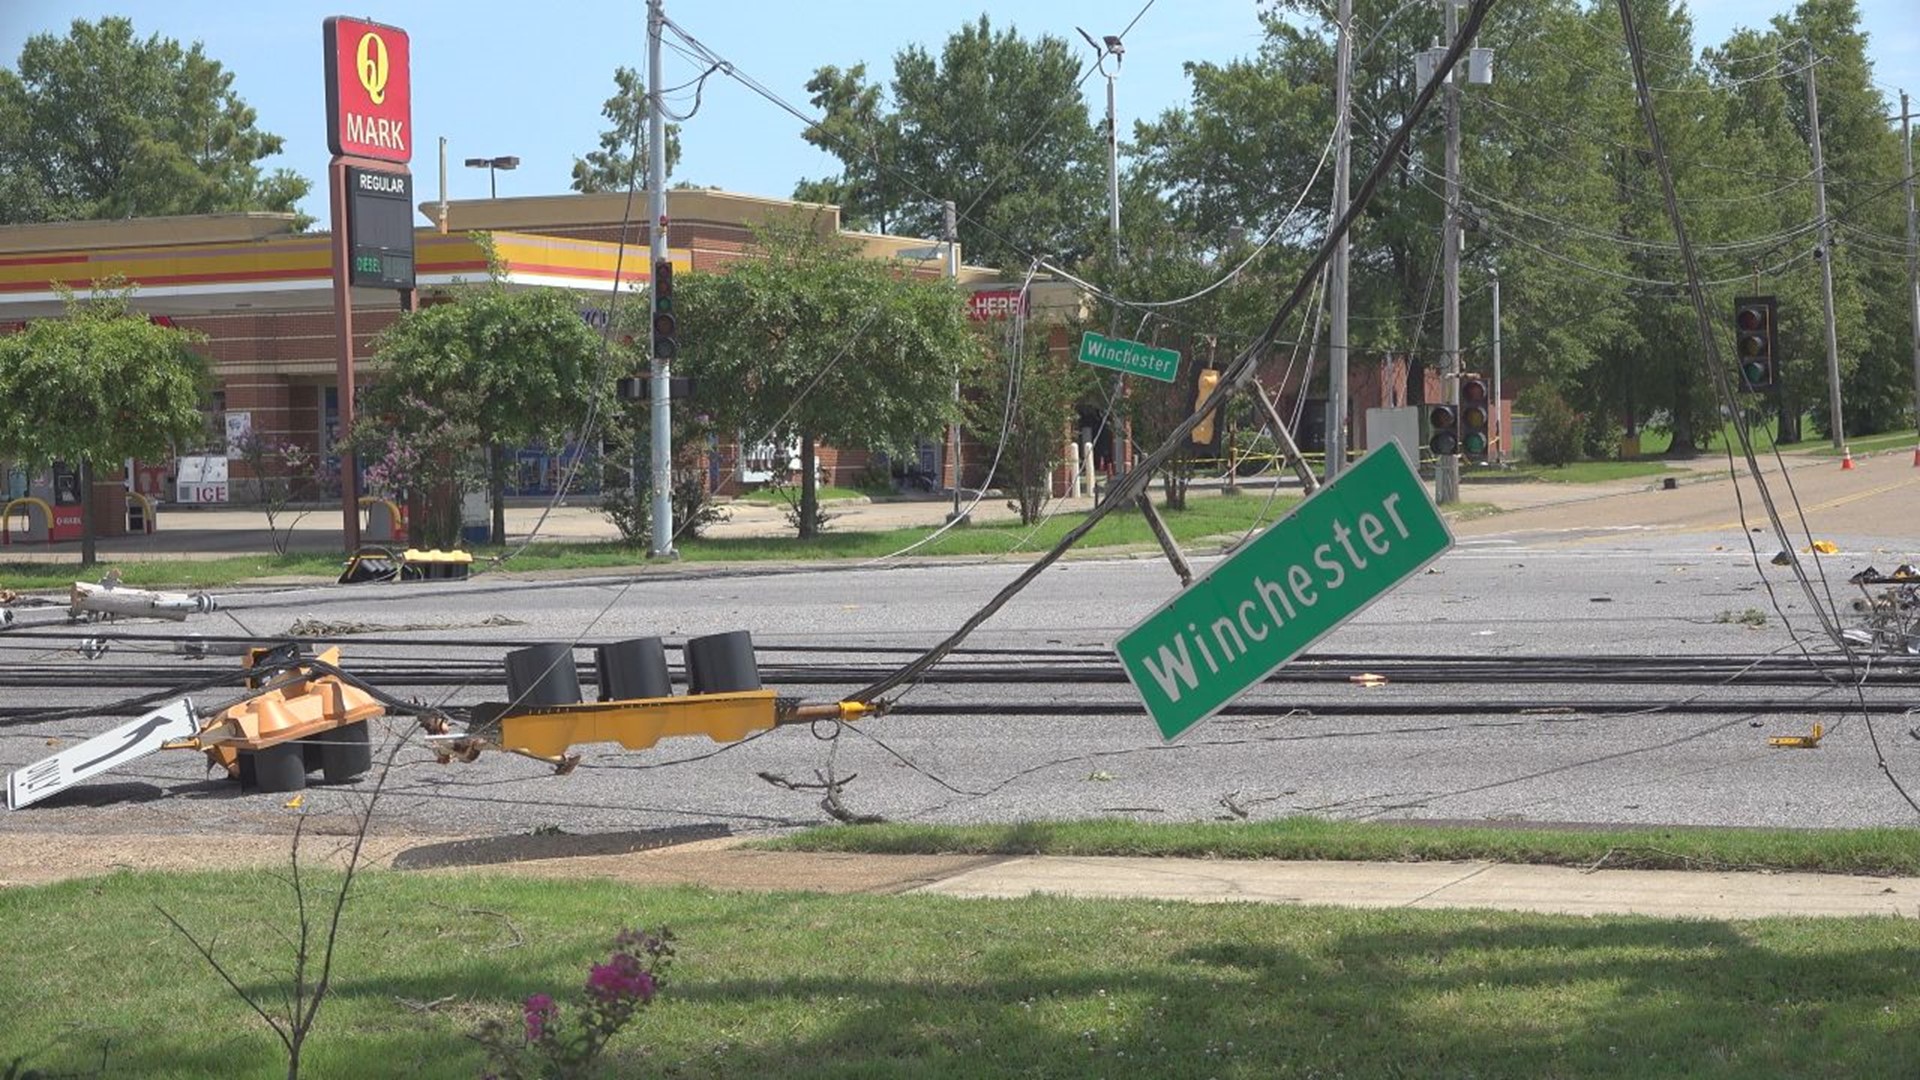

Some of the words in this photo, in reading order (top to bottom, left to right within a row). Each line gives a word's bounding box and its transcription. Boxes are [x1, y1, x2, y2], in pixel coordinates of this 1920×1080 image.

[356, 32, 389, 104] Q
[347, 112, 405, 150] MARK
[360, 174, 404, 194] REGULAR
[1087, 340, 1172, 373] Winchester
[195, 486, 226, 502] ICE
[1142, 492, 1410, 703] Winchester
[26, 758, 61, 795] ONLY
